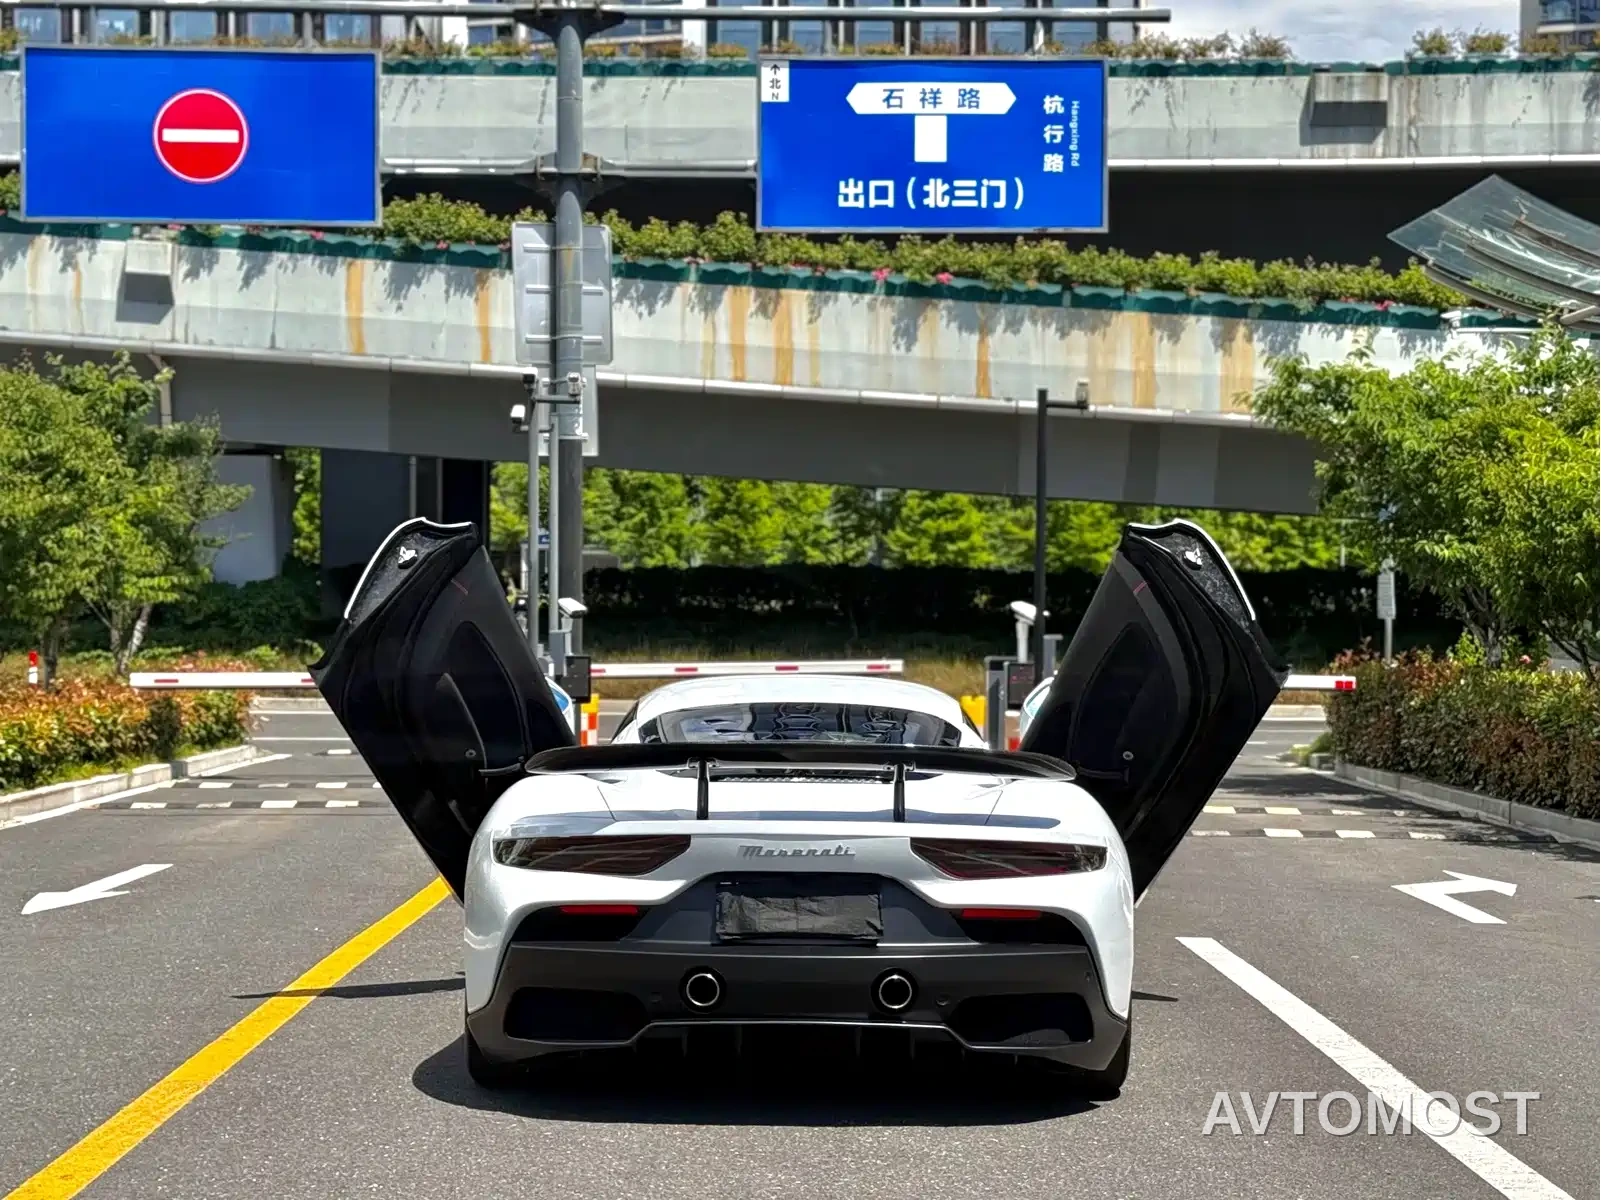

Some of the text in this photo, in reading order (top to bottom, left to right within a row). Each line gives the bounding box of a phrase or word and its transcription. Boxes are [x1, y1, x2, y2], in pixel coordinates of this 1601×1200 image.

[769, 77, 781, 90] 北
[771, 92, 779, 101] N
[882, 87, 980, 109] 石祥路
[1043, 94, 1065, 173] 杭行路
[1068, 100, 1080, 167] Hangxing Rd
[738, 844, 856, 860] Maserati
